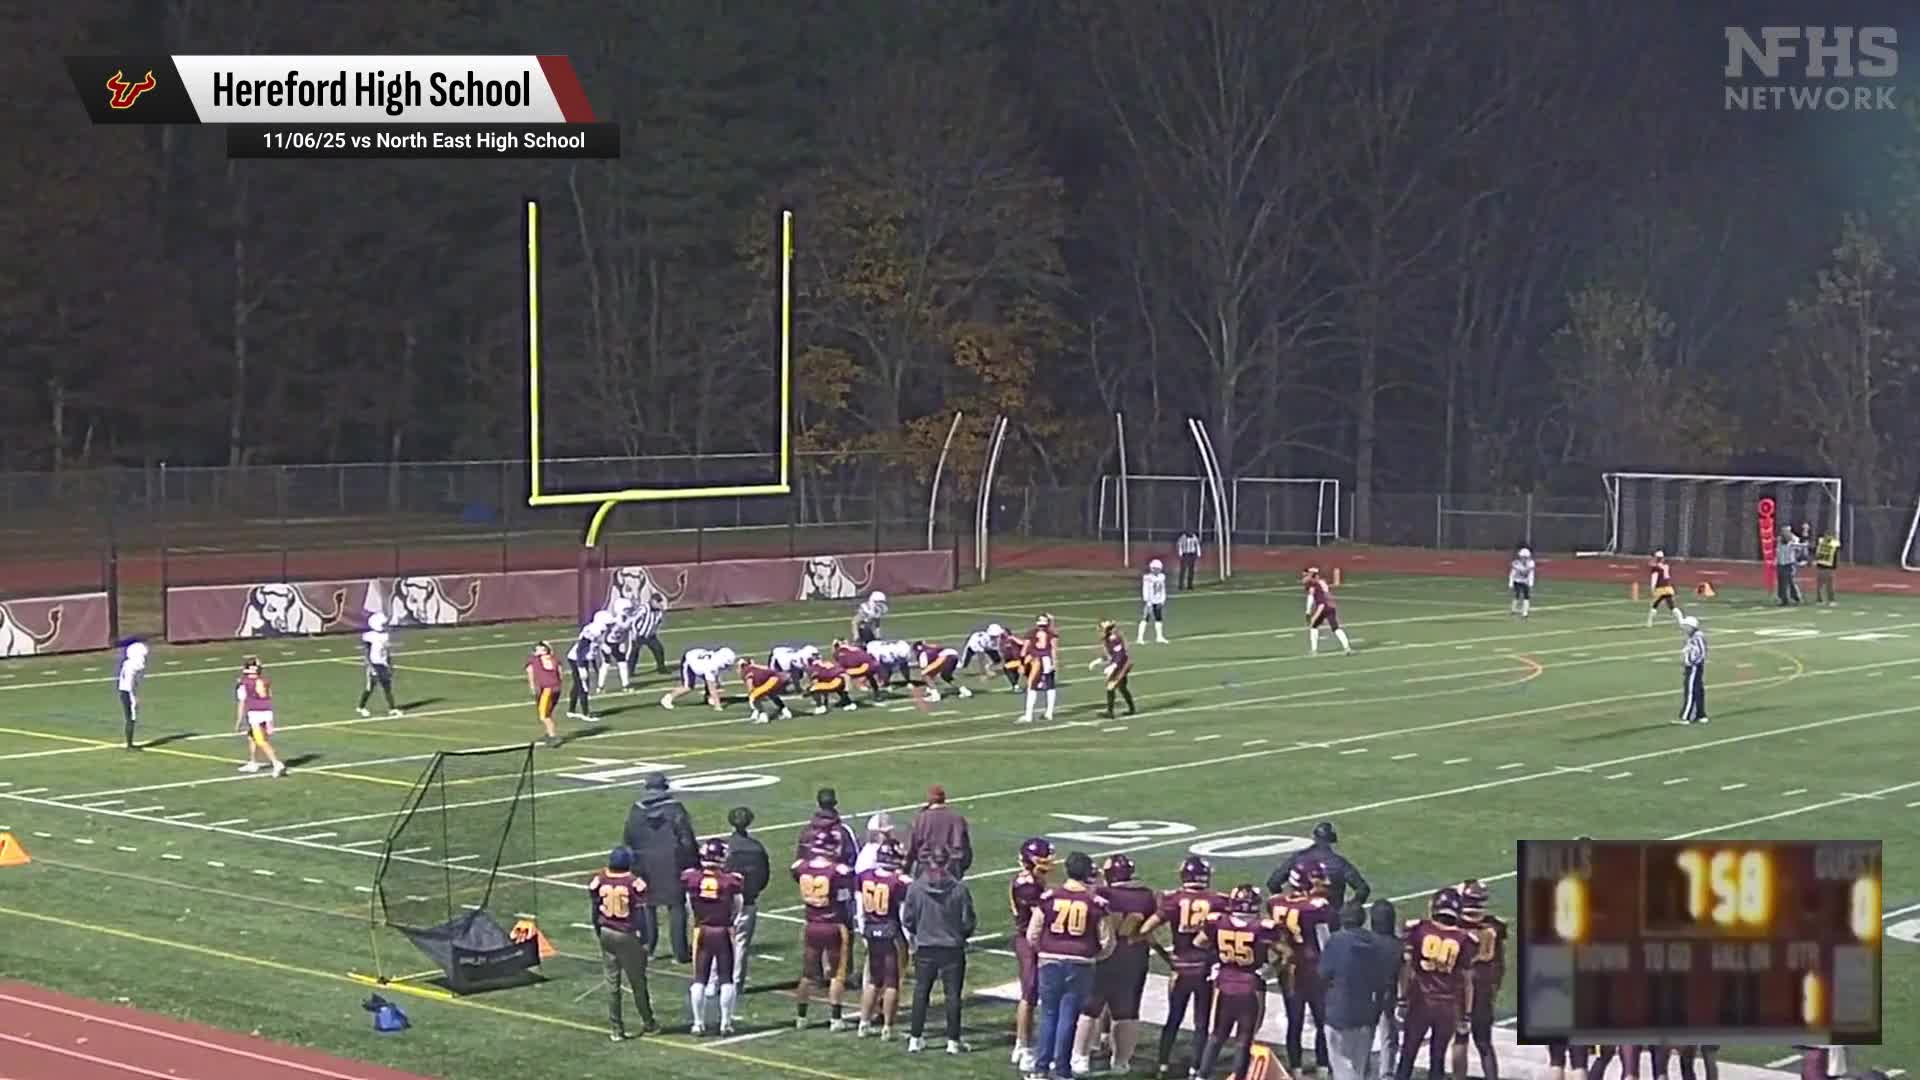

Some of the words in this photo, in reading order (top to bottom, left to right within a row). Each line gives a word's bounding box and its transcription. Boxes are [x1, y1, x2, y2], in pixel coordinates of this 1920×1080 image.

[1050, 899, 1089, 936] 70
[1178, 898, 1210, 933] 12
[1217, 928, 1255, 966] 55
[1420, 934, 1460, 974] 90
